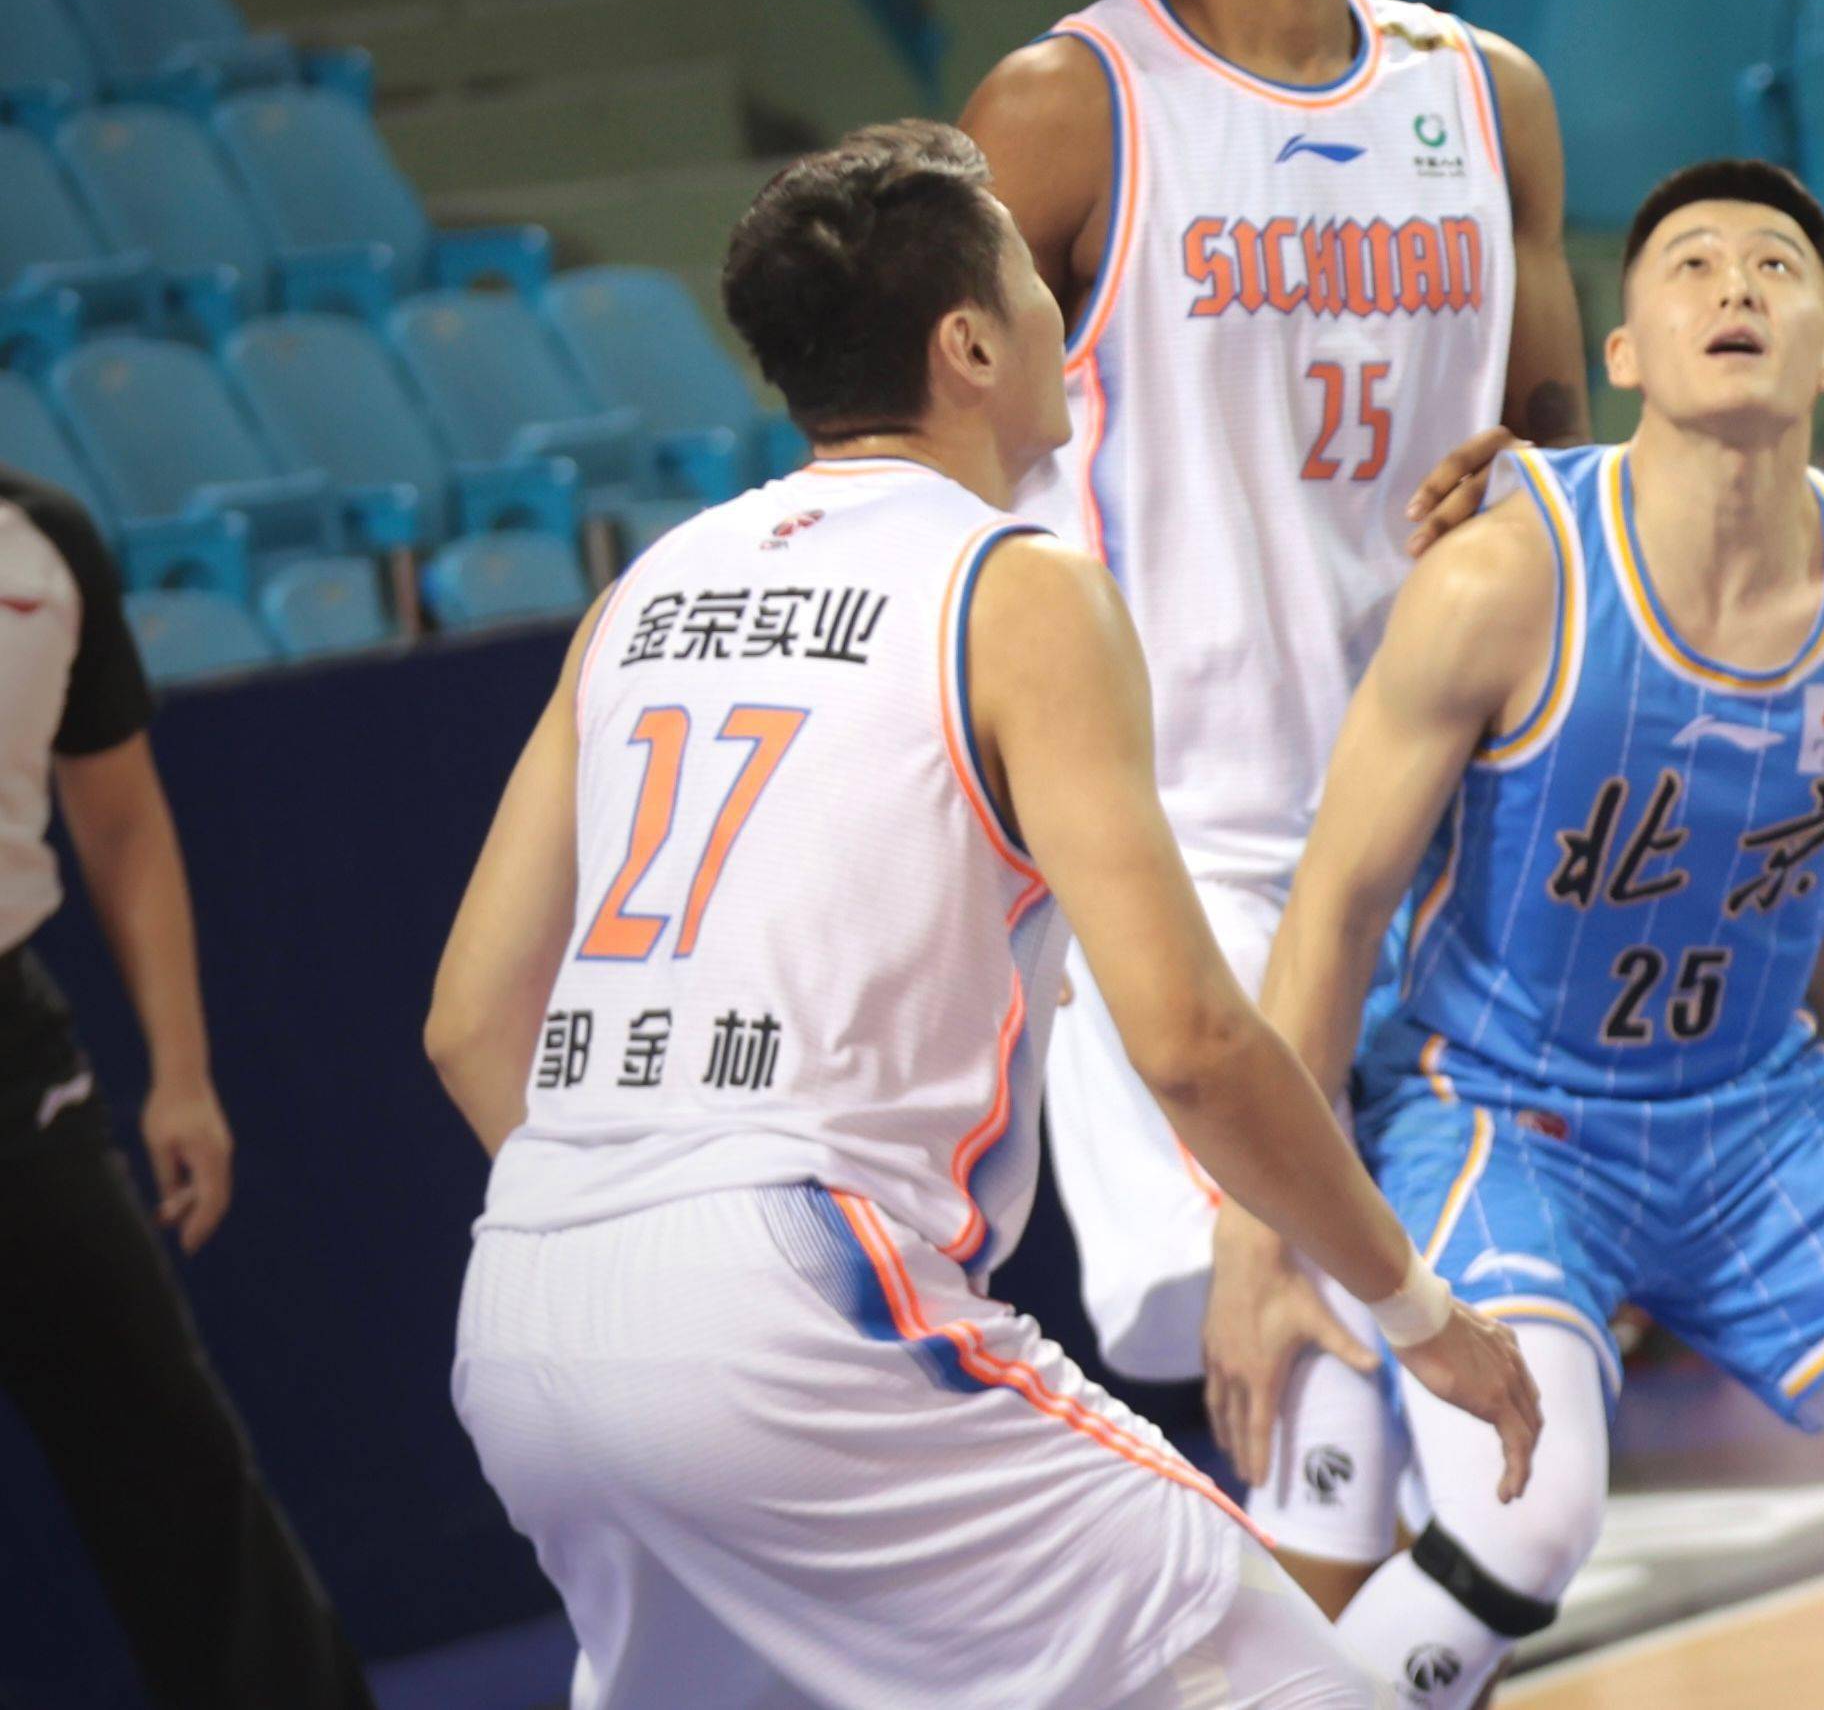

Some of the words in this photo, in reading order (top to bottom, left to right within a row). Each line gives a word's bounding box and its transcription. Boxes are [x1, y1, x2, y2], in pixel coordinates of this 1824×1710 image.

[1181, 215, 1484, 319] SICHUAN
[1299, 360, 1392, 482] 25
[619, 587, 889, 667] 金荣实业
[574, 702, 812, 963] 27
[1599, 943, 1734, 1046] 25
